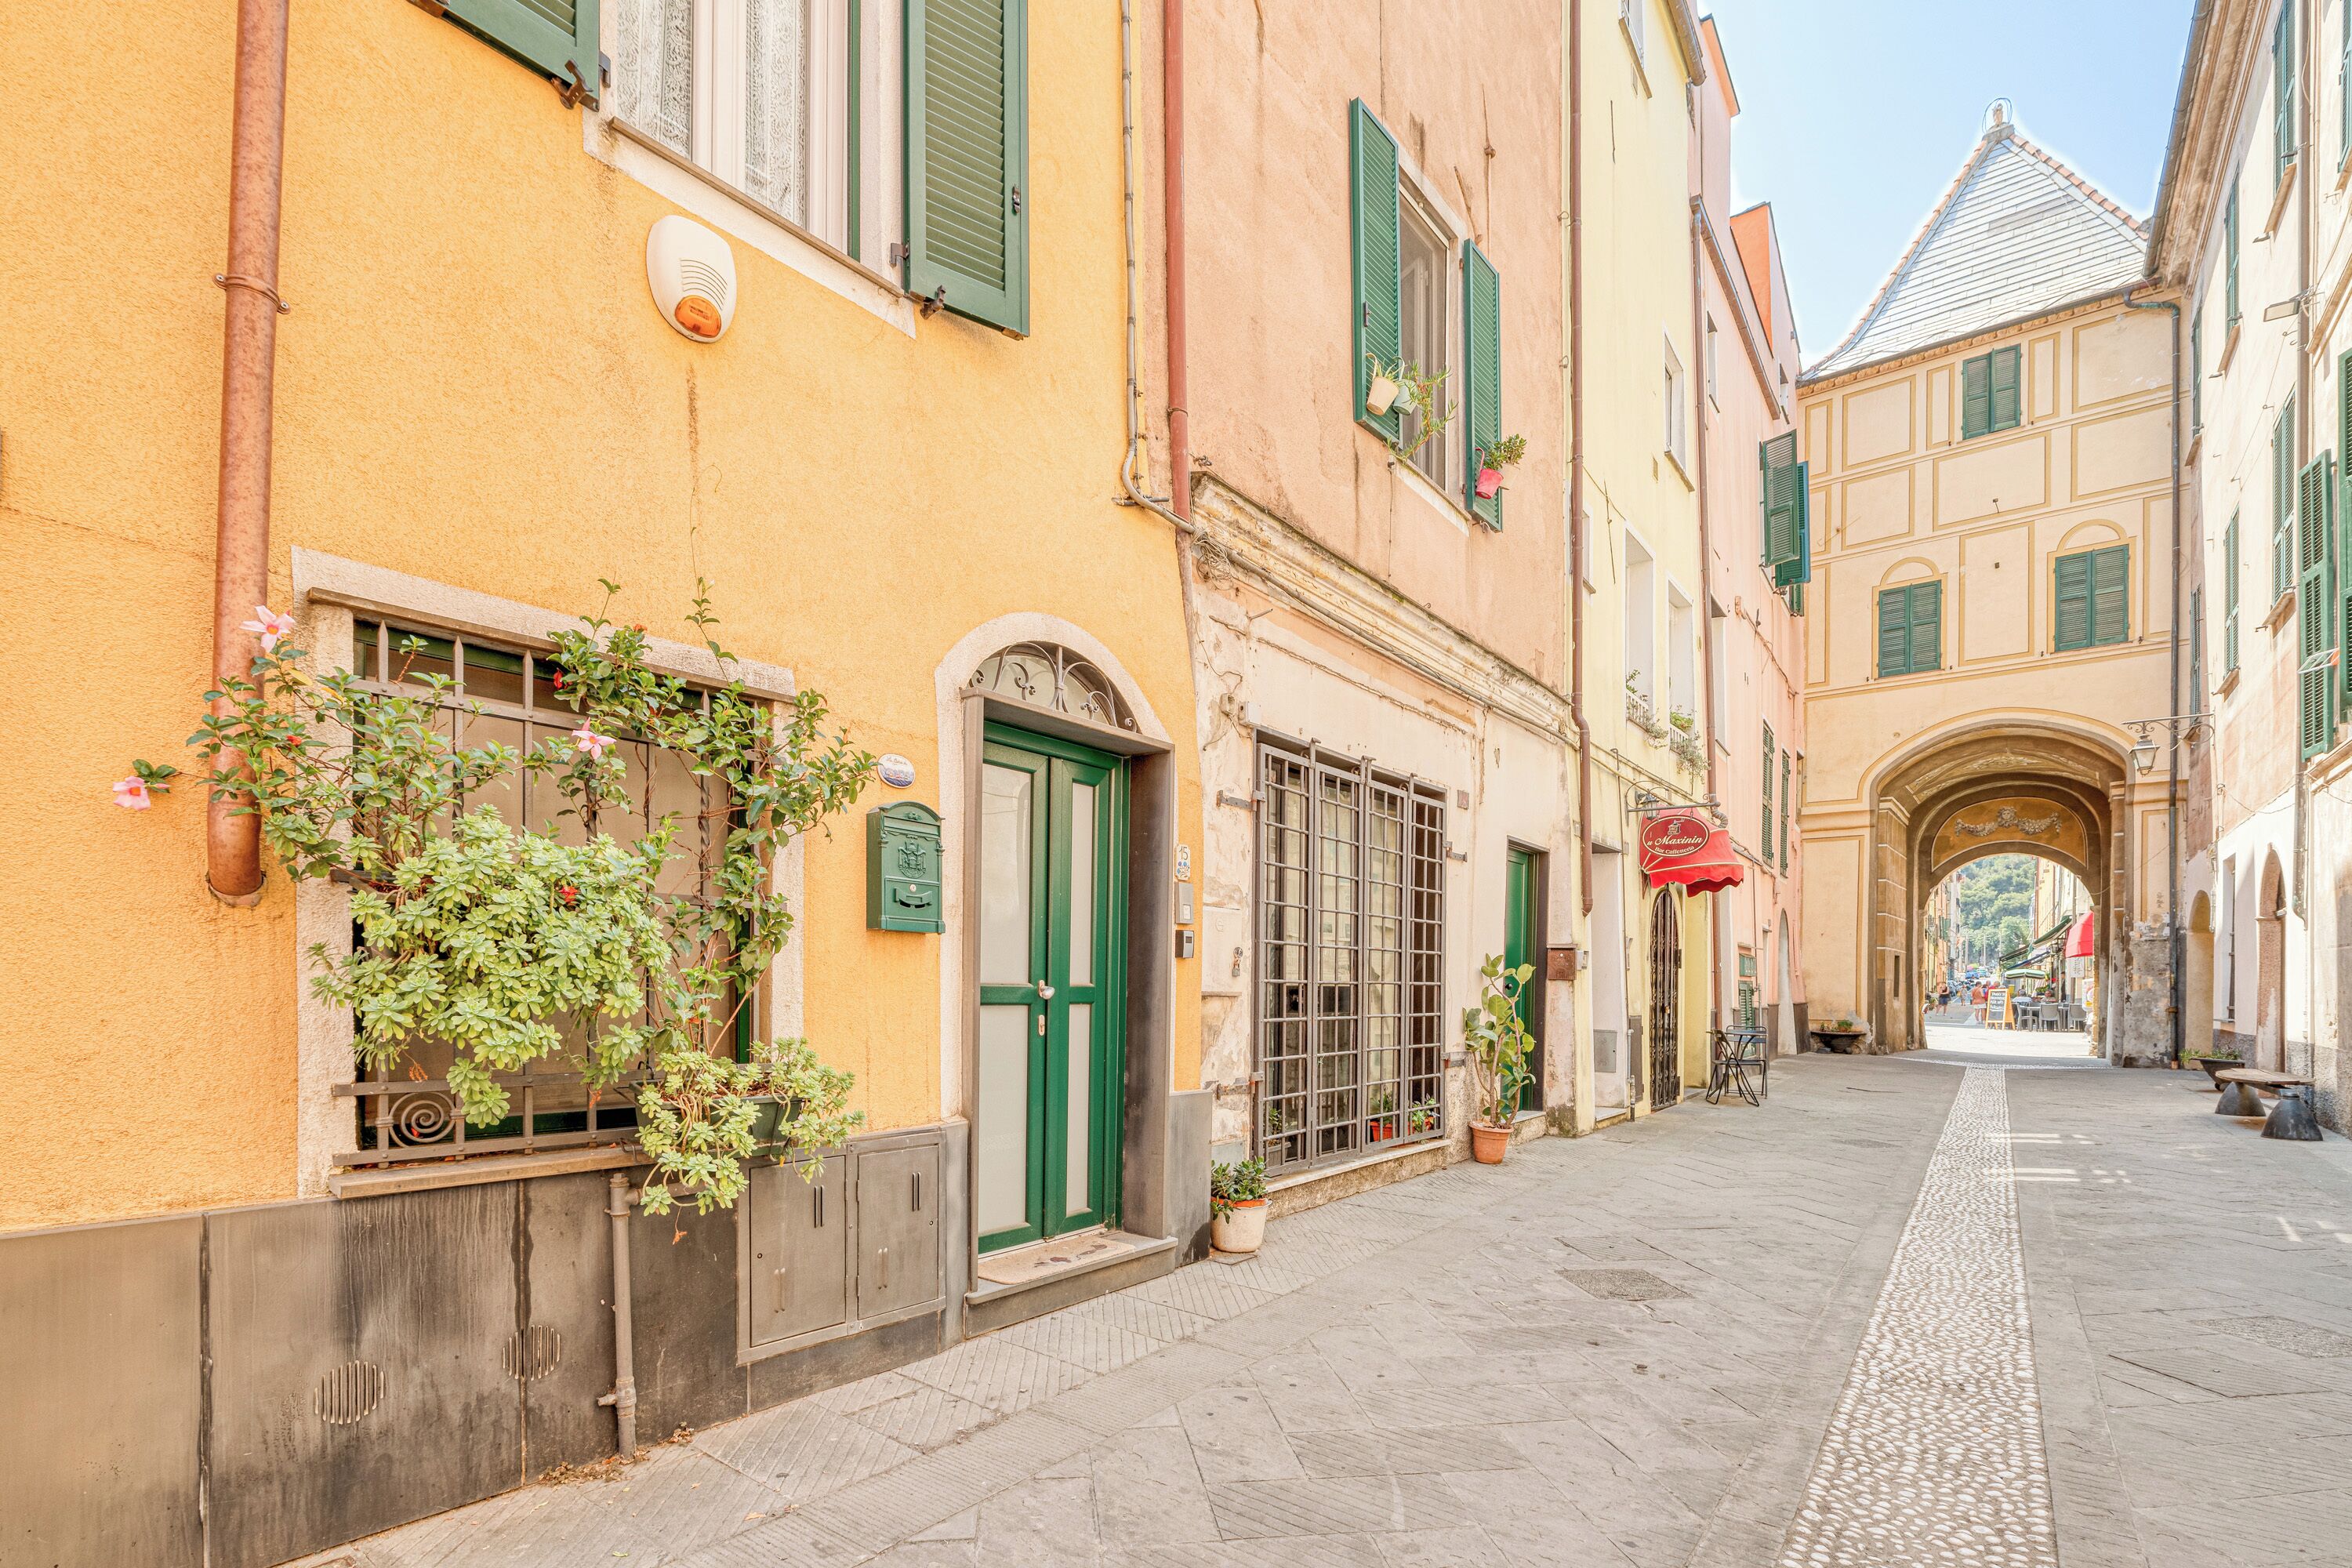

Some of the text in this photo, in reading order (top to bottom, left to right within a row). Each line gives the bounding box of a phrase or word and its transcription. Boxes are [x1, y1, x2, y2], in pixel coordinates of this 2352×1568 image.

[1654, 835, 1703, 846] Maxinin
[1178, 846, 1189, 860] 15
[1665, 846, 1695, 855] Caffetteria
